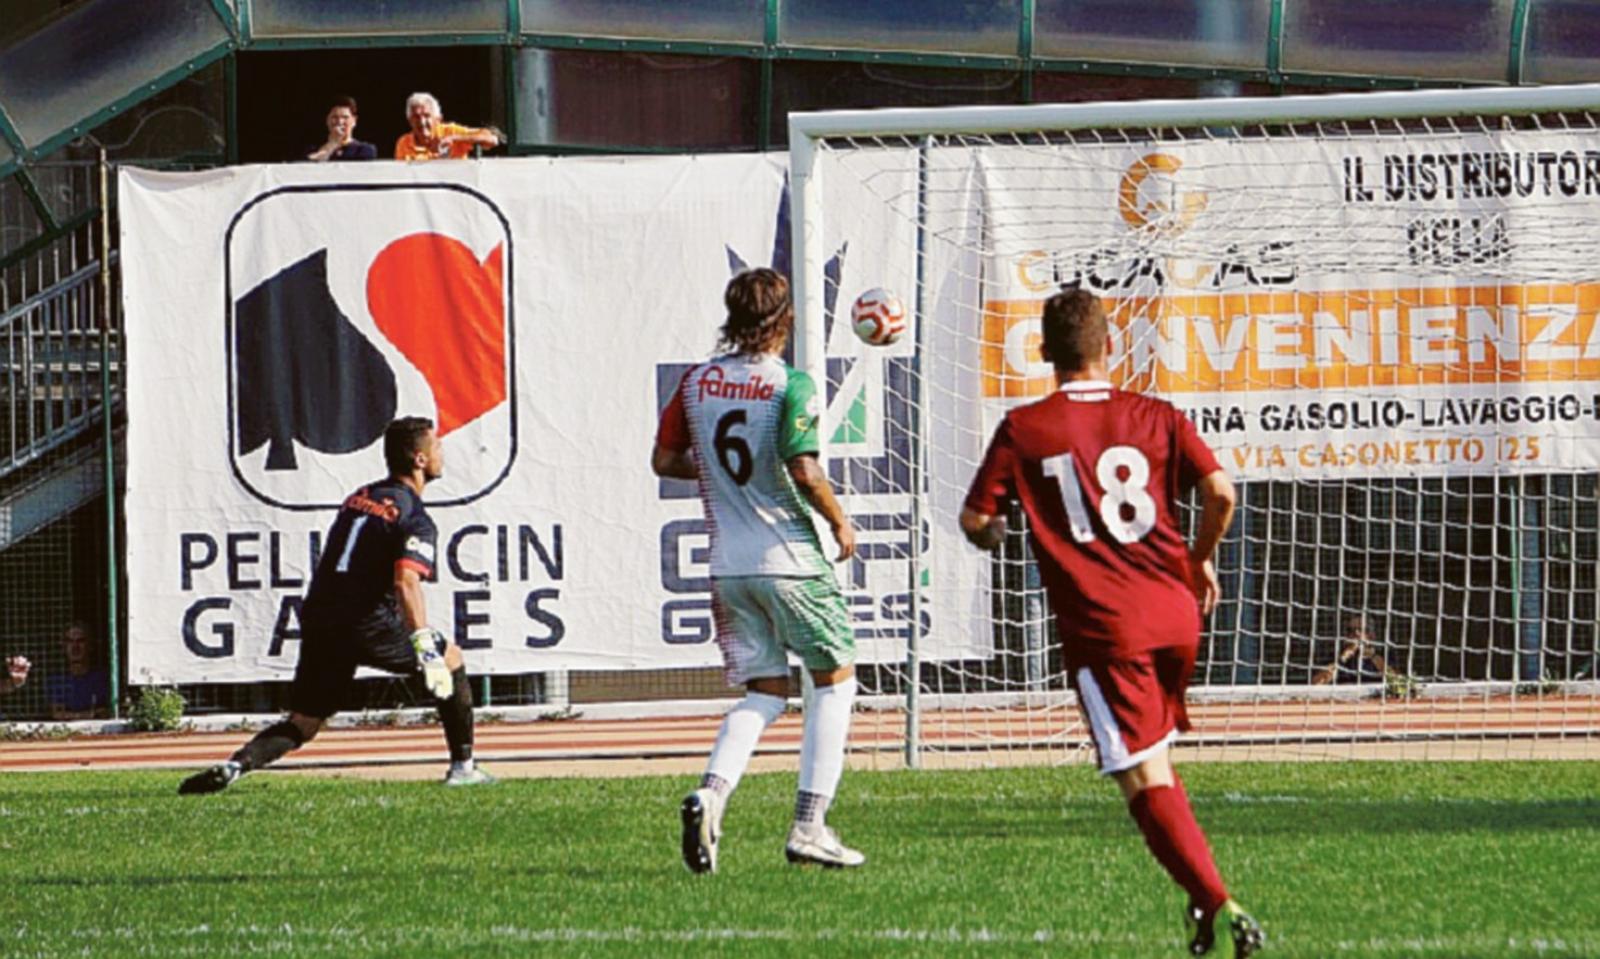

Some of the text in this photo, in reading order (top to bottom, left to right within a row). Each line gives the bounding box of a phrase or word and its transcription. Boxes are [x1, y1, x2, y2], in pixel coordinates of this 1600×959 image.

[1343, 156, 1374, 202] IL
[1003, 303, 1600, 378] CNVENIENZ
[713, 408, 753, 487] 6
[1189, 407, 1246, 433] INA
[1232, 447, 1286, 470] VIA
[1298, 437, 1485, 468] CASONETTO
[1041, 445, 1157, 544] 18
[180, 524, 563, 591] PELCIN
[336, 515, 369, 572] 1
[181, 587, 567, 659] GAES
[661, 594, 931, 644] GES
